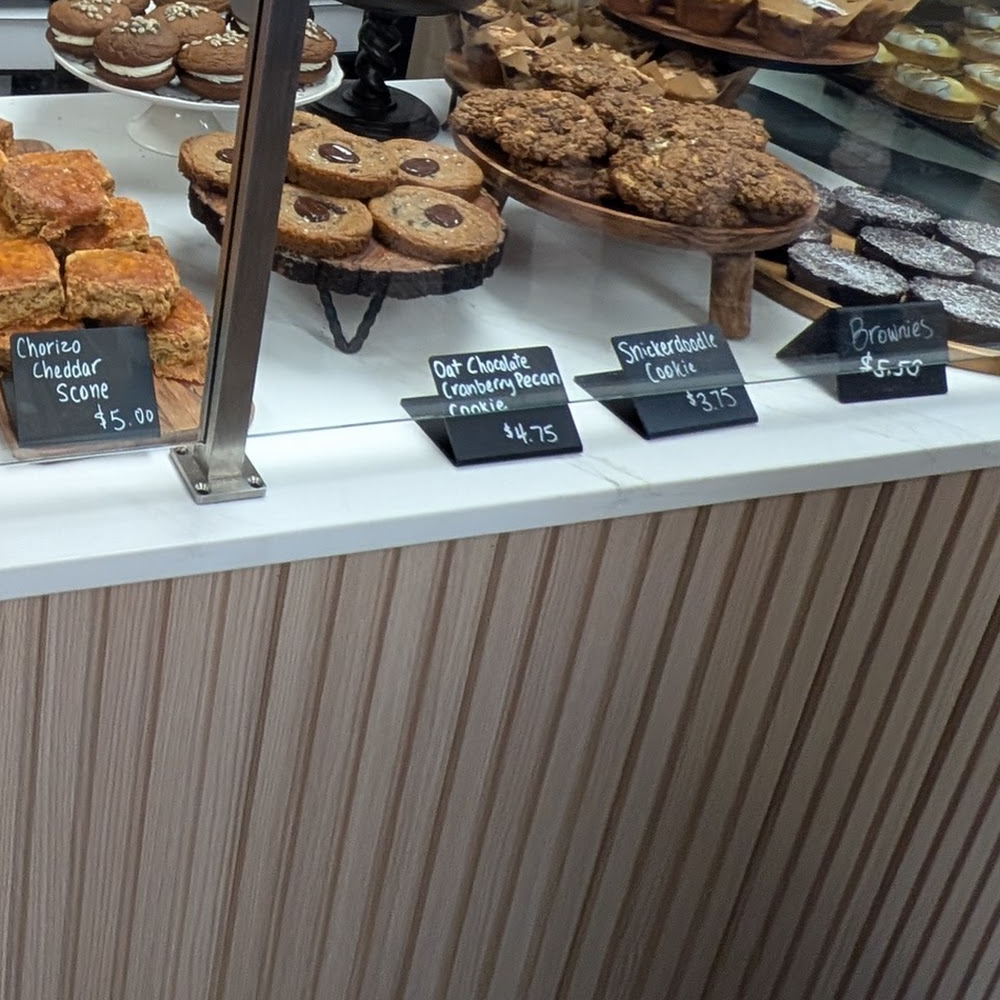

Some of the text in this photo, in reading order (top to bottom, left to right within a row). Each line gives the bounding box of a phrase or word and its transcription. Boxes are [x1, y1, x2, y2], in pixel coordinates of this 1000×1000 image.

[849, 317, 934, 351] Brownies
[16, 336, 81, 359] Chorizo
[618, 331, 718, 364] Snickerdoodle
[33, 358, 102, 379] Cheddar
[433, 352, 531, 379] Oat Chocolate
[645, 360, 697, 383] Cookie
[859, 351, 923, 378] $5.50
[56, 382, 109, 403] Scone
[441, 371, 561, 399] Cranberry Pecan
[686, 387, 737, 412] $3.75
[94, 404, 154, 430] $5.00
[503, 422, 558, 444] $4.75
